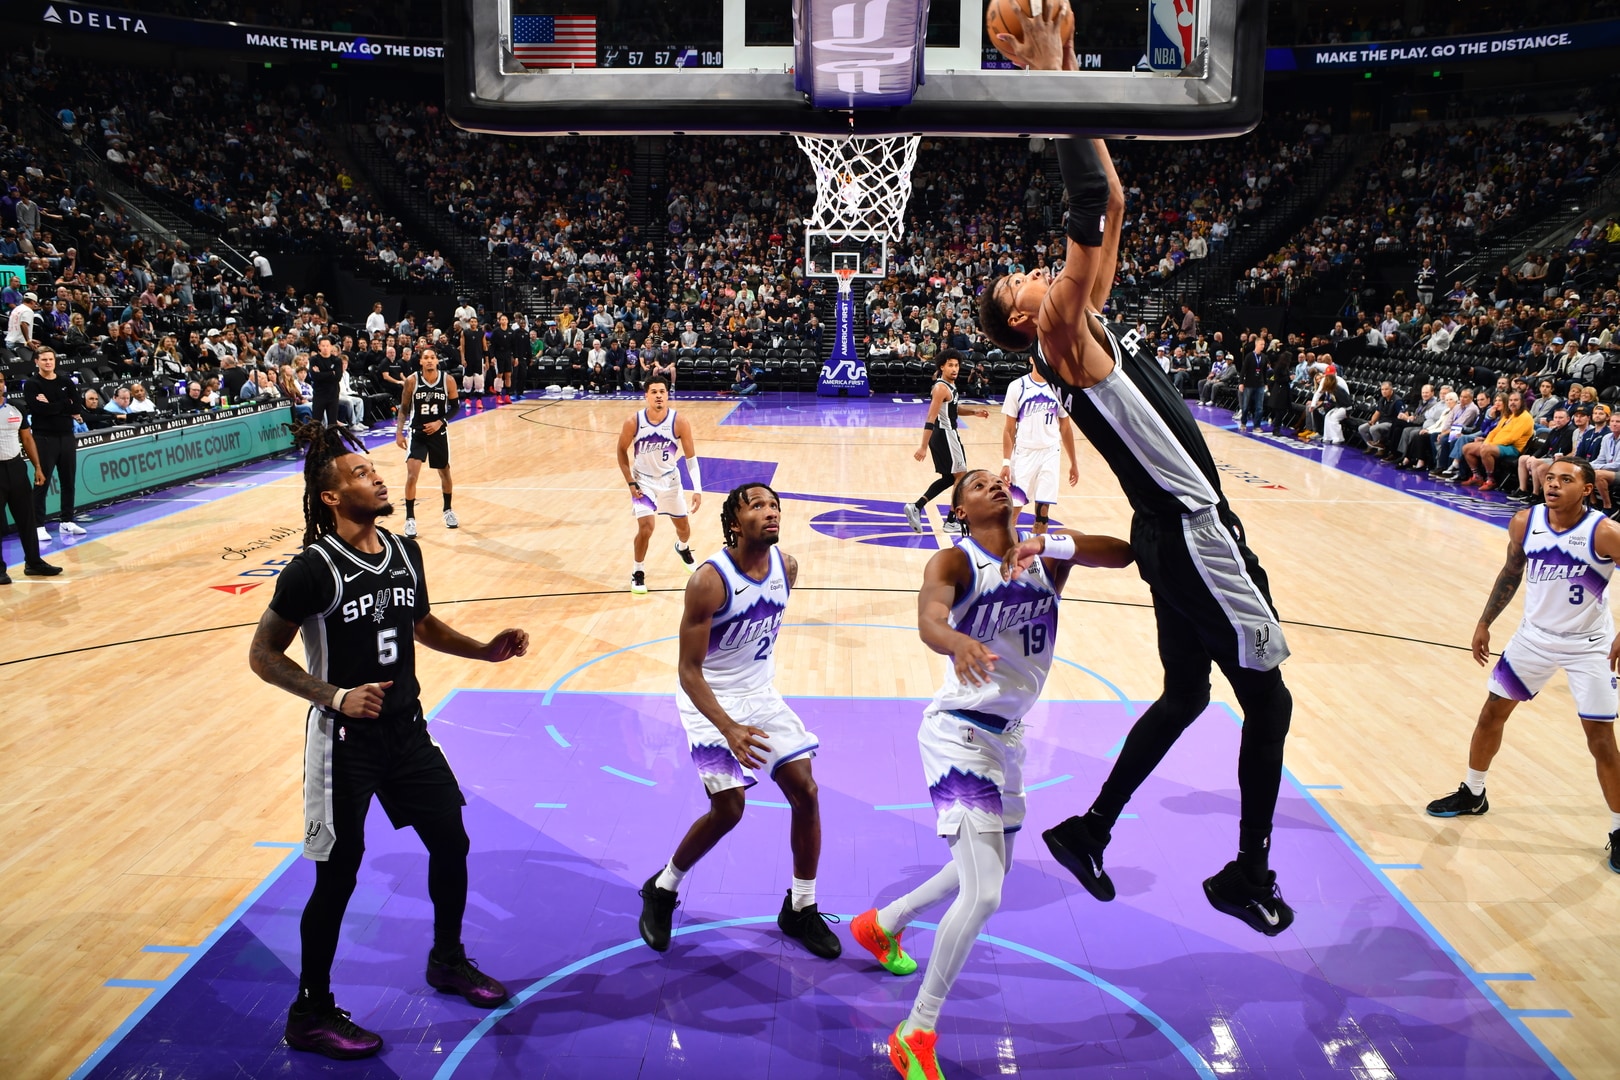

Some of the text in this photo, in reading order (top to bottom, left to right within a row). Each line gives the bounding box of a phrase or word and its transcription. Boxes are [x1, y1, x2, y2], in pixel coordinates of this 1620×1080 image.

[69, 9, 148, 34] DELTA
[246, 33, 288, 49] MAKE
[291, 38, 318, 51] THE
[321, 41, 356, 53] PLAY.
[360, 43, 381, 55] GO
[384, 45, 411, 57] THE
[1316, 33, 1572, 64] MAKE THE PLAY. GO THE DISTANCE.
[628, 51, 644, 65] 57
[655, 51, 670, 65] 57
[701, 51, 721, 65] 10:0
[1085, 54, 1102, 68] PM
[1154, 47, 1176, 65] NBA
[1119, 328, 1141, 358] SP
[415, 391, 446, 402] SPURS
[261, 403, 273, 411] DELTA
[420, 403, 439, 415] 24
[1023, 400, 1057, 417] UTAH
[172, 419, 187, 428] DELTA
[196, 415, 211, 423] DELTA
[1044, 412, 1054, 425] 11
[115, 429, 134, 439] DELTA
[145, 424, 161, 433] DELTA
[83, 435, 104, 445] DELTA
[639, 440, 672, 454] UTAH
[100, 431, 241, 483] PROTECT HOME COURT
[662, 450, 669, 461] 5
[1526, 557, 1590, 584] UTAH
[770, 583, 784, 591] Equity
[1568, 584, 1584, 605] 3
[342, 587, 415, 624] SPURS
[969, 595, 1054, 644] UTAH
[718, 608, 786, 651] UTAH
[376, 626, 398, 666] 5
[753, 633, 777, 661] 2
[1019, 623, 1047, 657] 19
